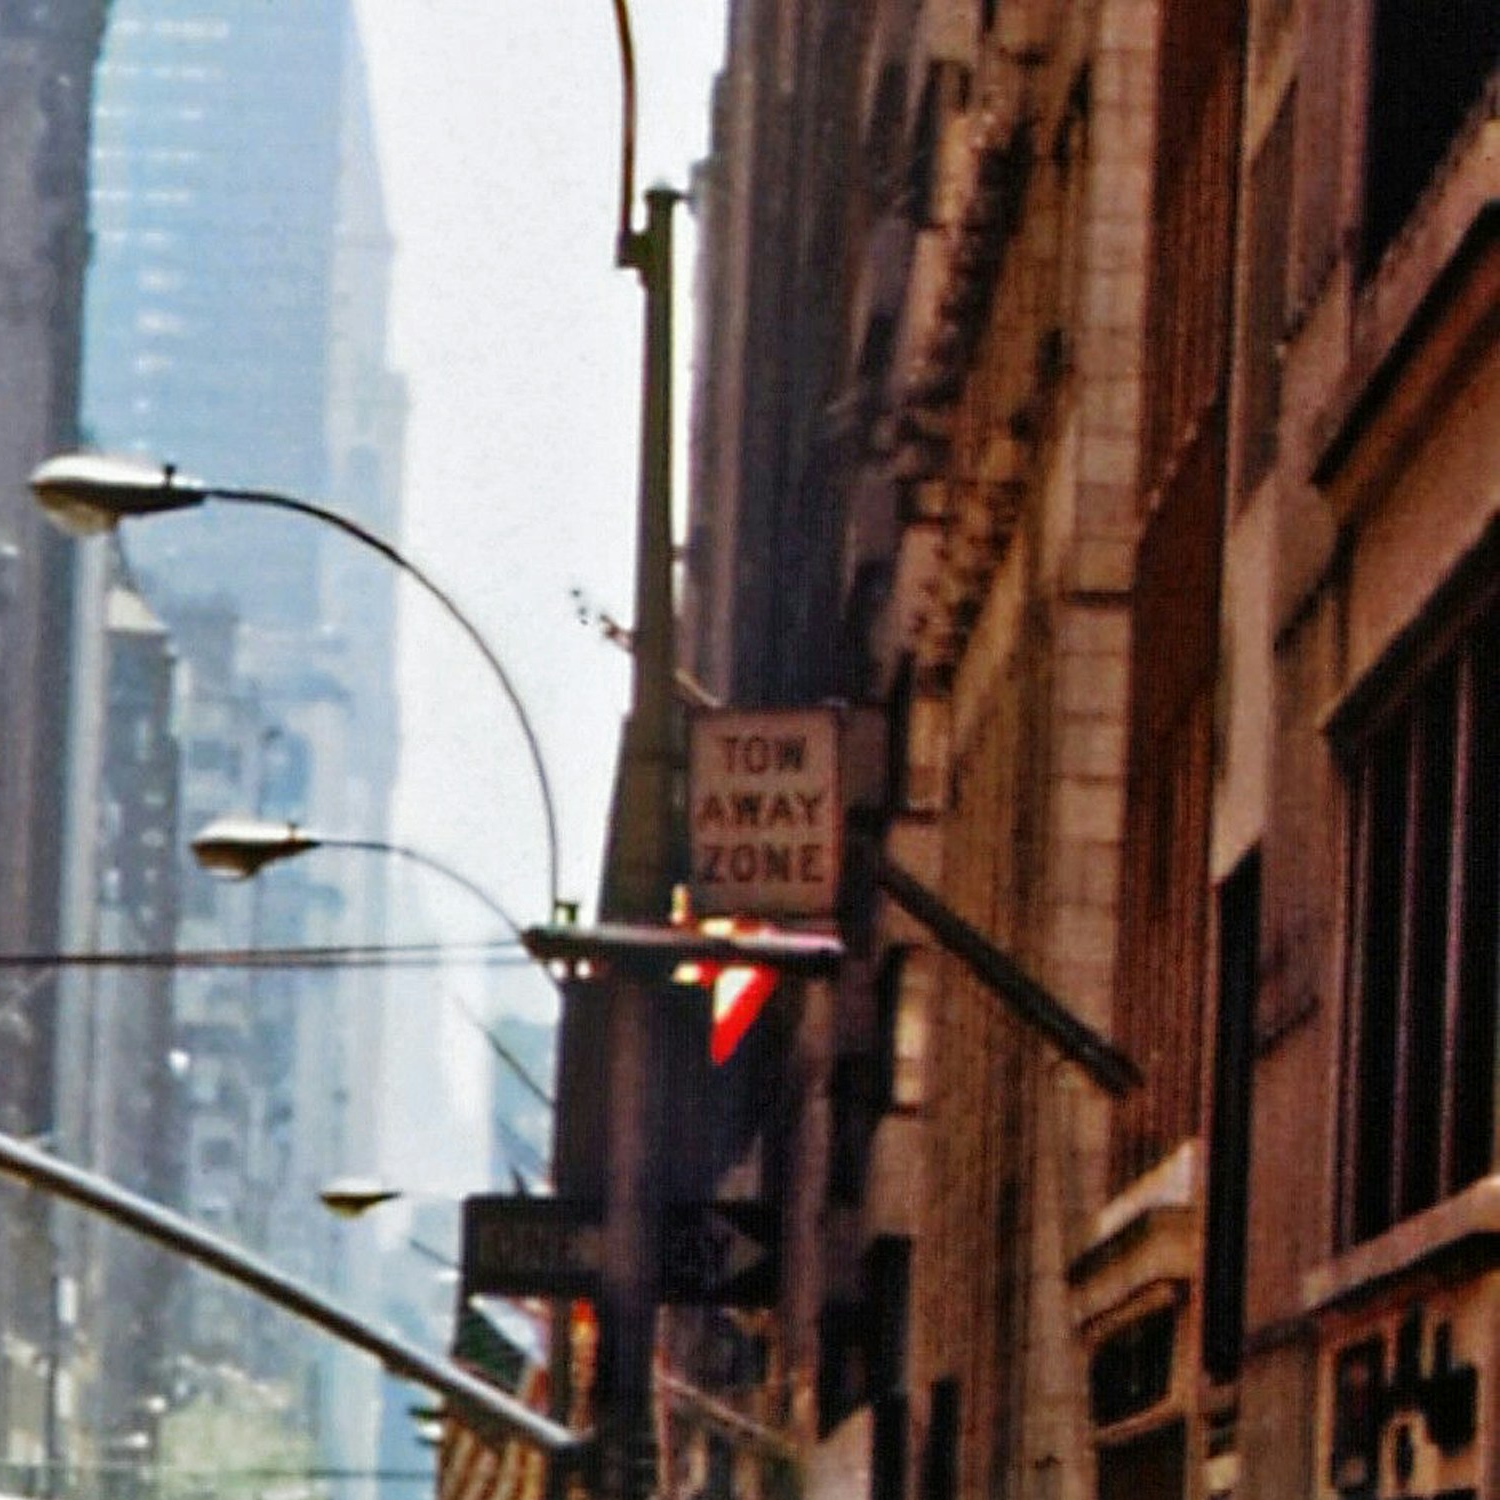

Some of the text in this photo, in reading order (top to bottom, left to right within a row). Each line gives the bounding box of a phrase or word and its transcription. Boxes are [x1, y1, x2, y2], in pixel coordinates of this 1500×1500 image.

[720, 735, 807, 774] TOW
[698, 790, 823, 830] AWAY
[701, 843, 825, 883] ZONE
